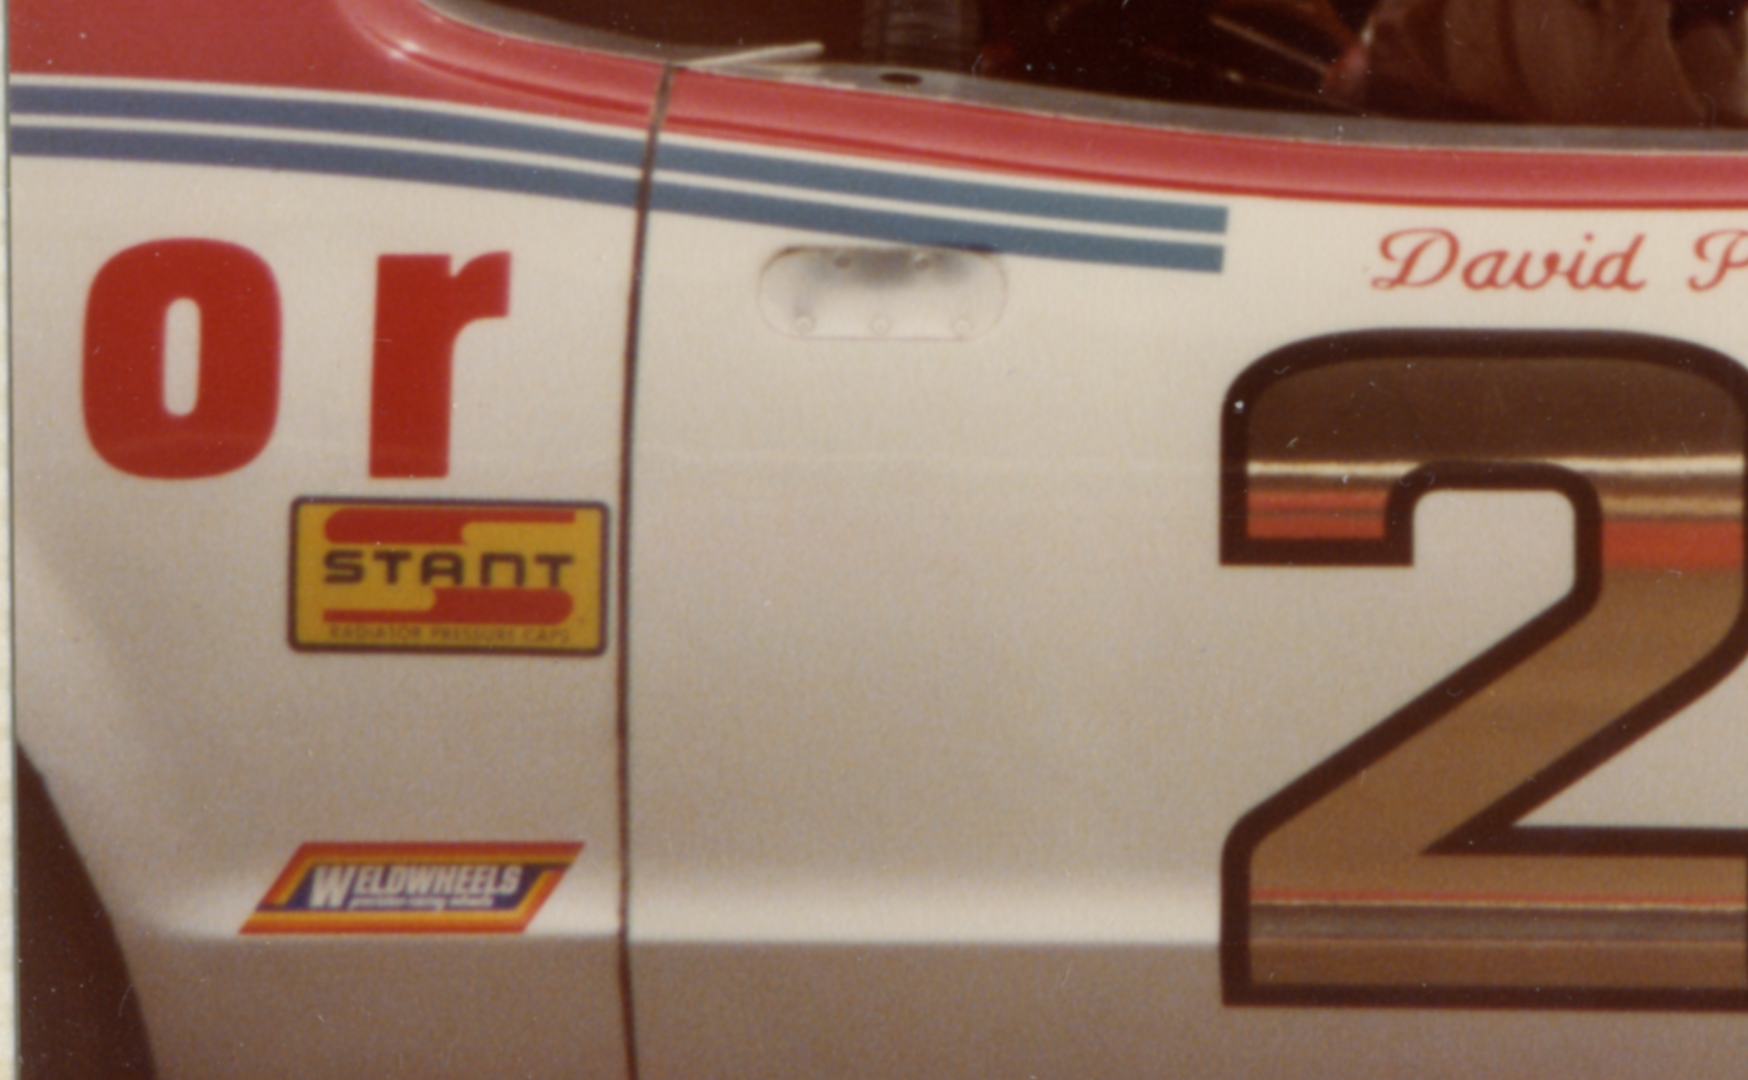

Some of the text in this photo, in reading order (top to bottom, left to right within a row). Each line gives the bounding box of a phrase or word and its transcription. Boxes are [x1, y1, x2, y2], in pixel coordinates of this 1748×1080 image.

[1371, 228, 1648, 292] David
[82, 237, 512, 480] or
[323, 549, 575, 588] STANT
